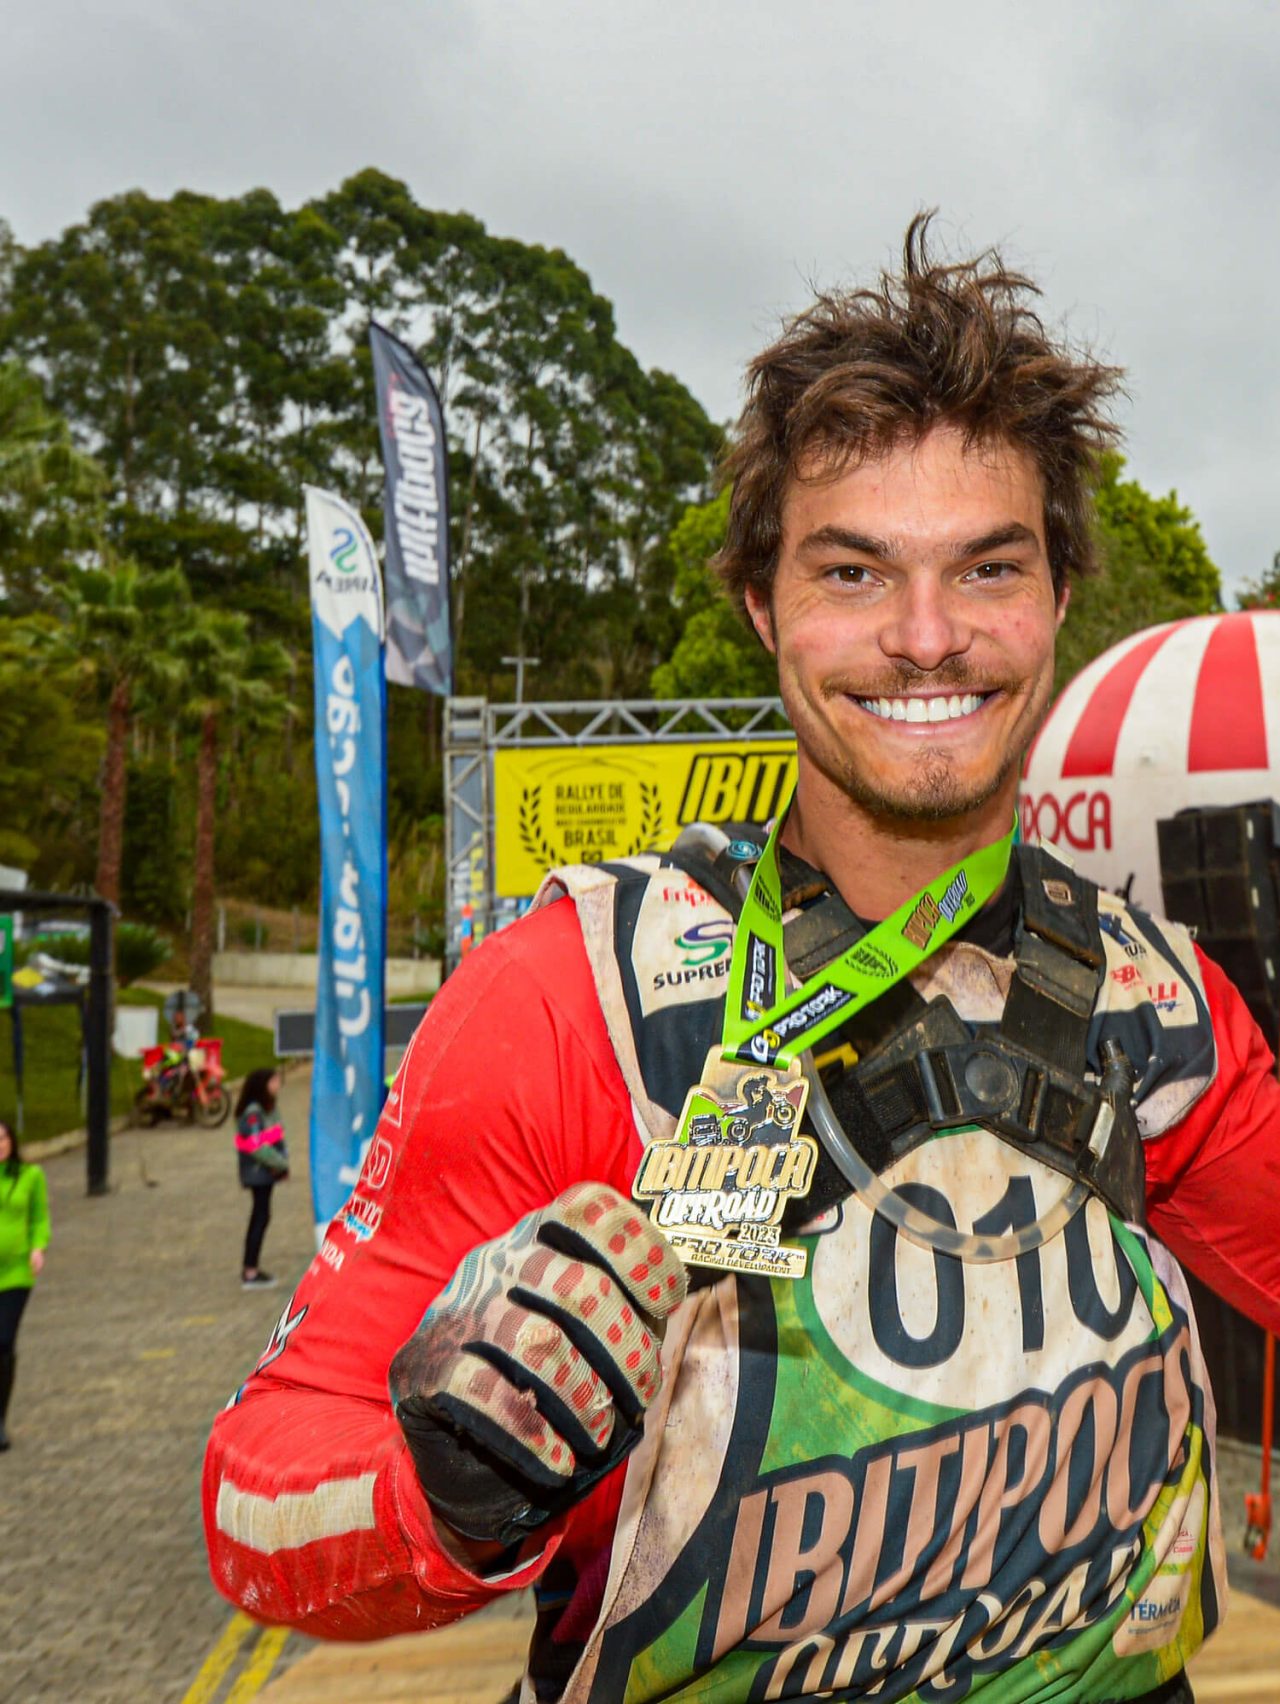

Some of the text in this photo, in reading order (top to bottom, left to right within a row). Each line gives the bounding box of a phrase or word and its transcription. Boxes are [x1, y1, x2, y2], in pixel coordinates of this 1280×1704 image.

[556, 782, 624, 799] RALLYE DE
[564, 829, 617, 848] BRASIL
[658, 1190, 778, 1231] OFFROAD
[741, 1222, 779, 1244] 2023
[670, 1234, 722, 1256] PRO
[726, 1242, 796, 1267] TORK
[726, 1255, 793, 1276] DEVELOPMENT
[868, 1174, 1140, 1370] 010
